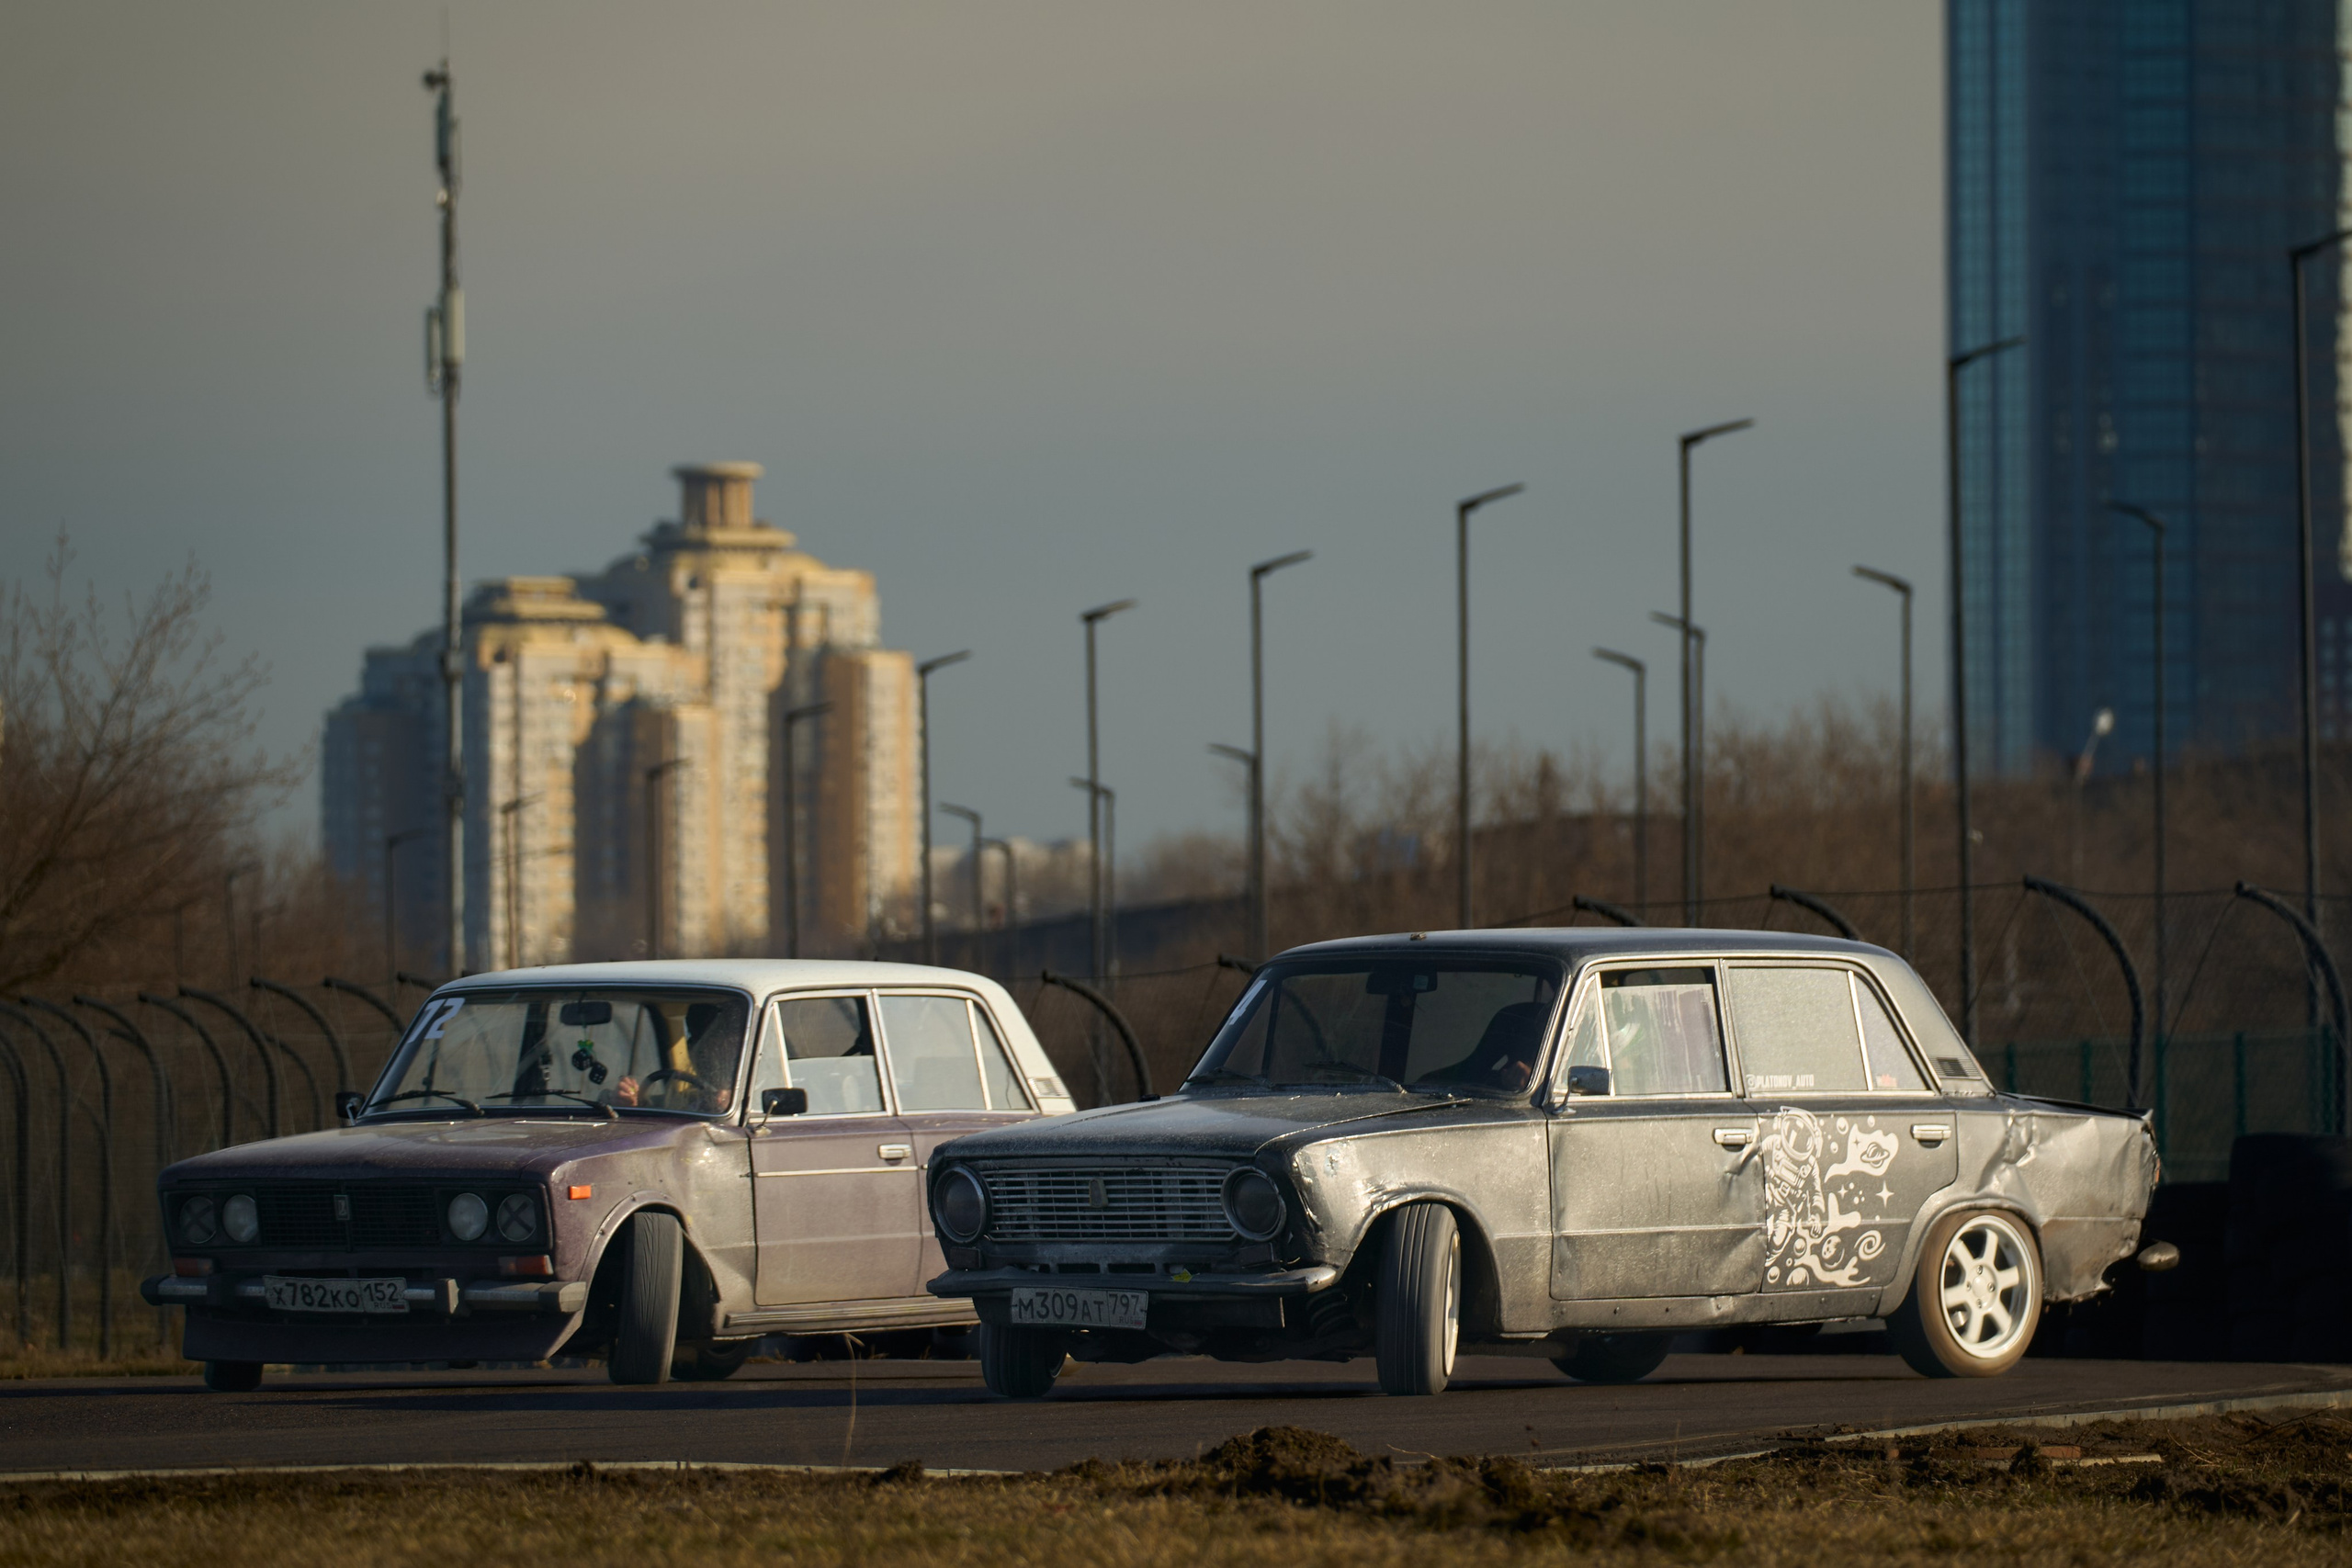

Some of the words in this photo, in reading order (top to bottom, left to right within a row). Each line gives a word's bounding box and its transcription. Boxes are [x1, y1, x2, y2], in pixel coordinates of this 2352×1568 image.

[407, 998, 466, 1043] 12
[364, 1282, 399, 1303] 152
[374, 1302, 392, 1310] RUS
[1108, 1293, 1140, 1315] 797
[1119, 1315, 1134, 1325] RUS
